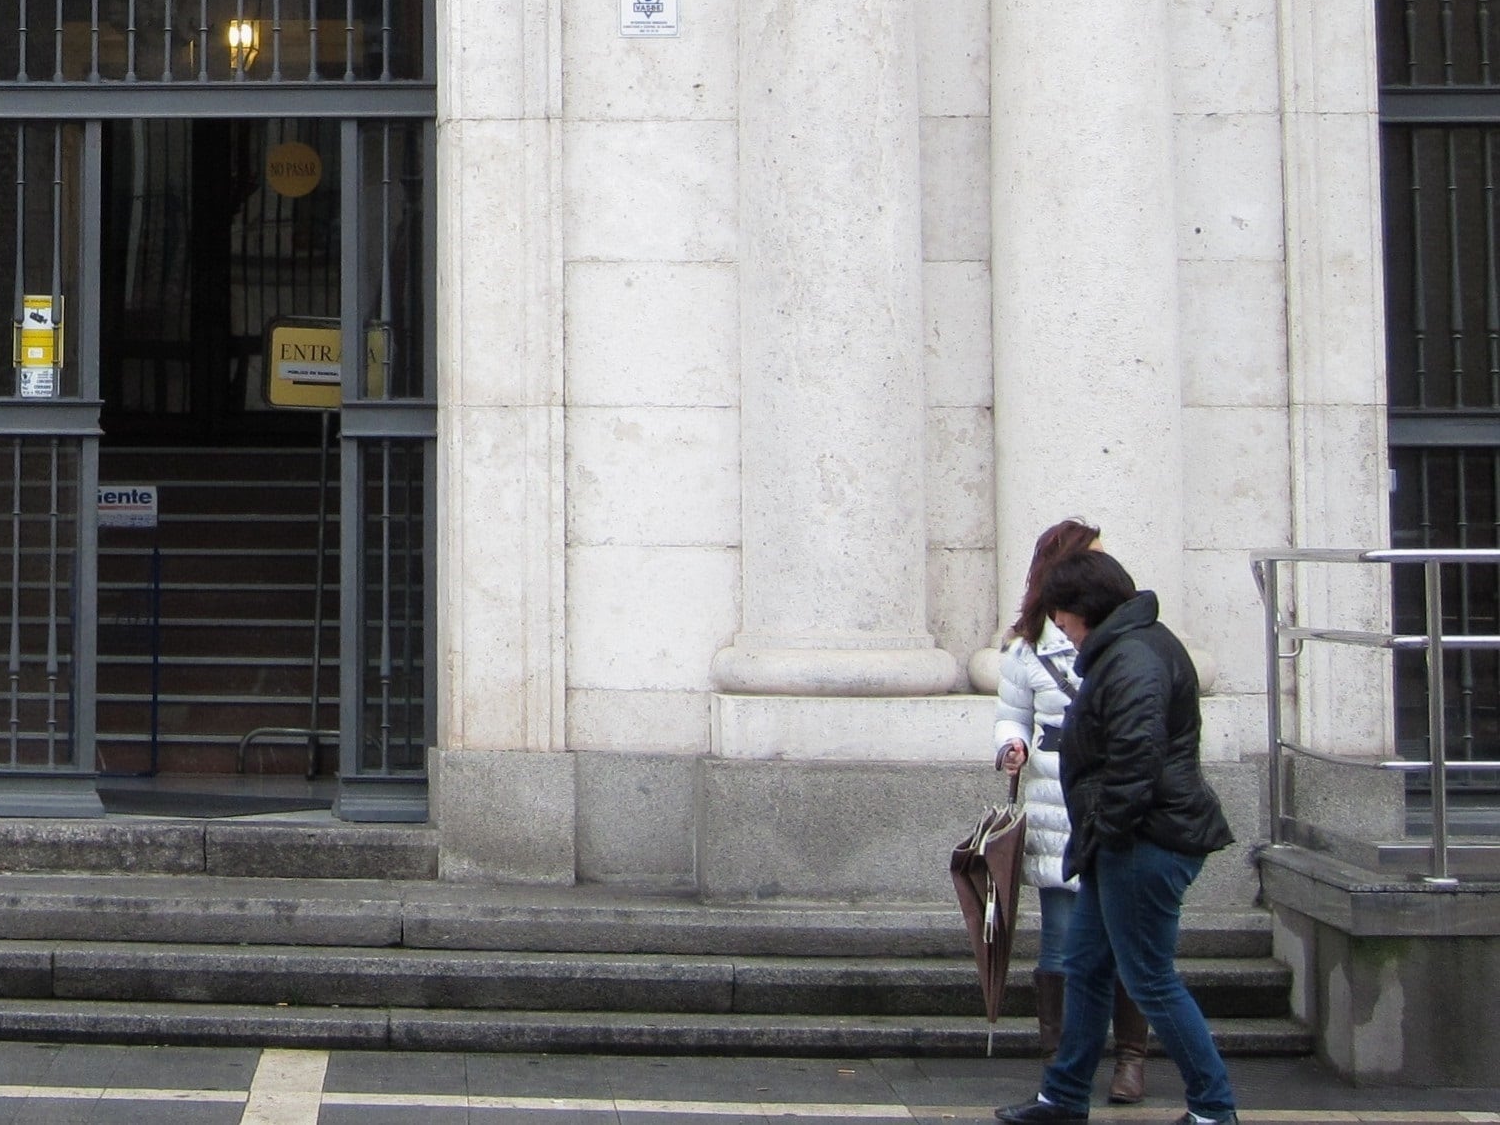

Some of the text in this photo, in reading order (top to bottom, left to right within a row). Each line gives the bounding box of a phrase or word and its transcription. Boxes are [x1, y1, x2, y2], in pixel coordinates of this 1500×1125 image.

[268, 161, 317, 177] NO PASAR
[280, 343, 377, 363] ENTRA
[98, 489, 153, 504] ente
